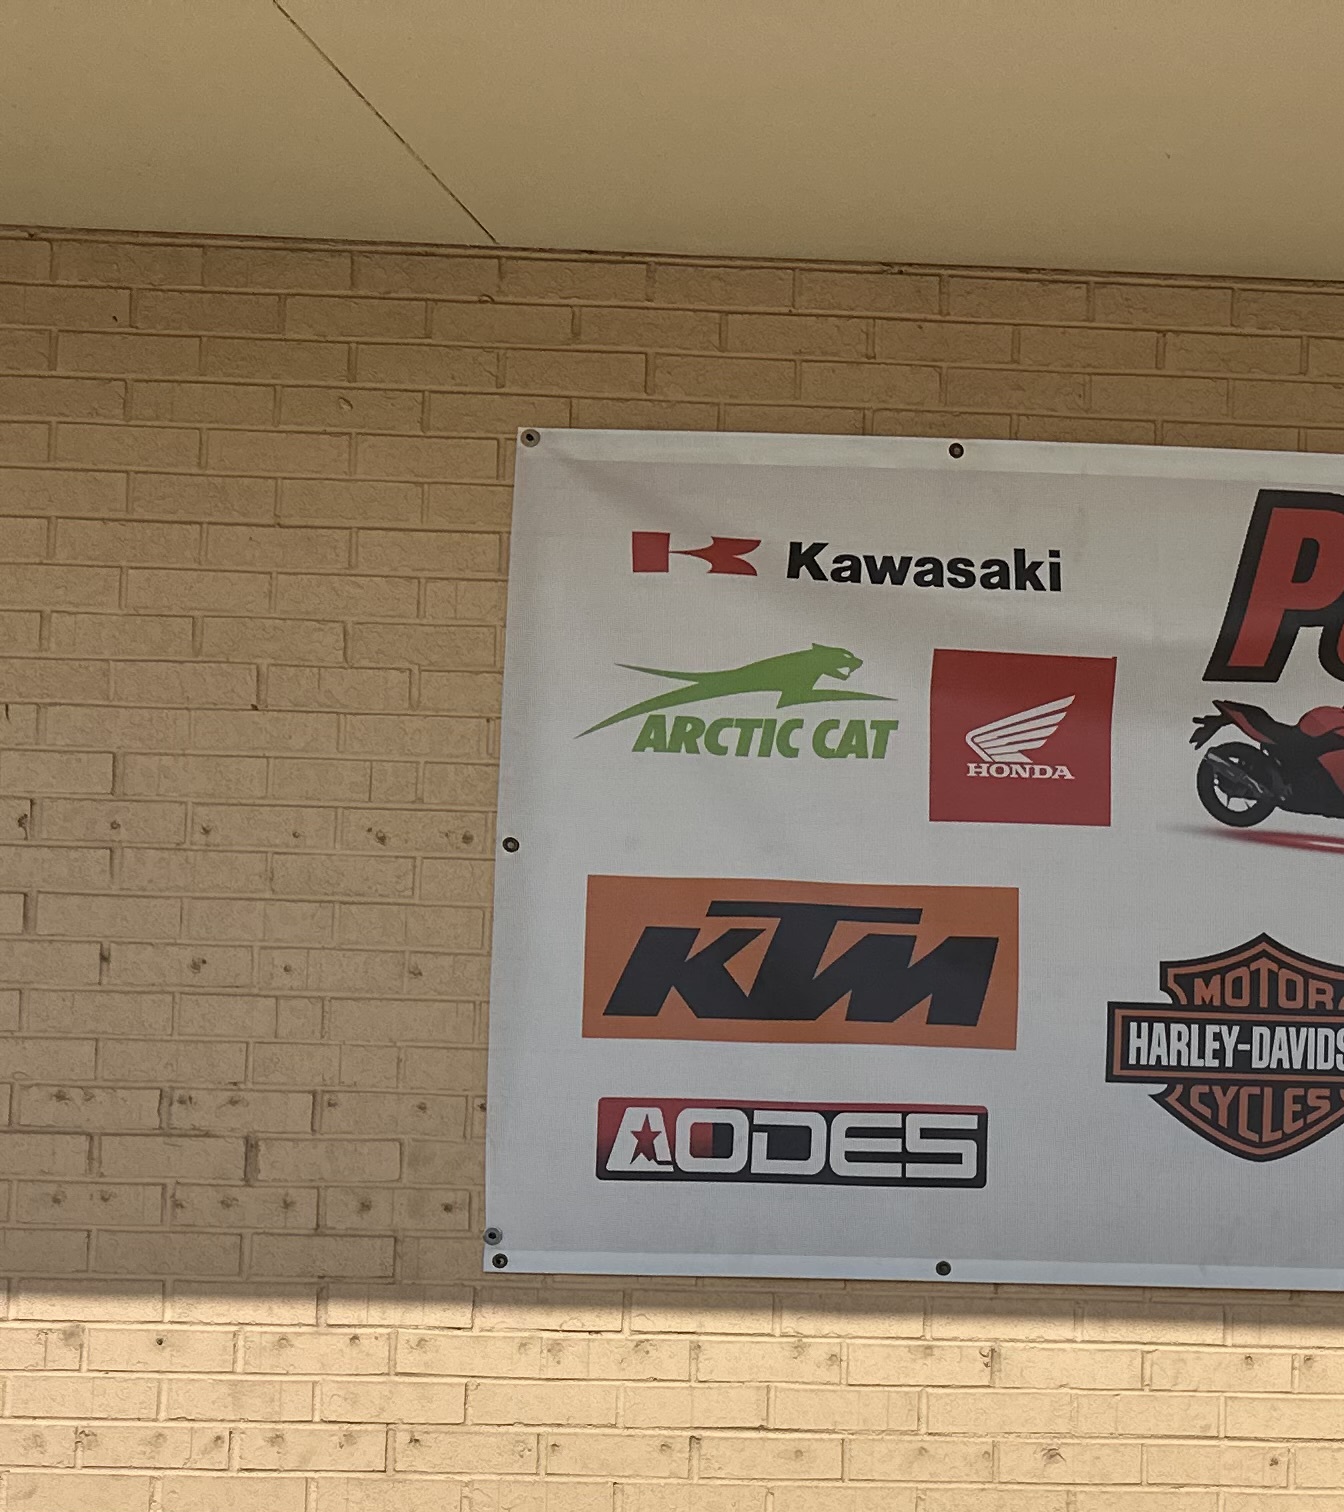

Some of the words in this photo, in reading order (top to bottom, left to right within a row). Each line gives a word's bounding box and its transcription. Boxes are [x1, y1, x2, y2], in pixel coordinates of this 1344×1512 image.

[786, 541, 1063, 592] Kawasaki
[632, 713, 804, 757] ARCTIC
[811, 718, 899, 760] CAT
[966, 761, 1075, 780] HONDA
[602, 899, 1000, 1027] KTM
[1194, 960, 1336, 1012] MOTOR
[1189, 1084, 1334, 1143] CYCLES
[605, 1106, 979, 1178] AODES
